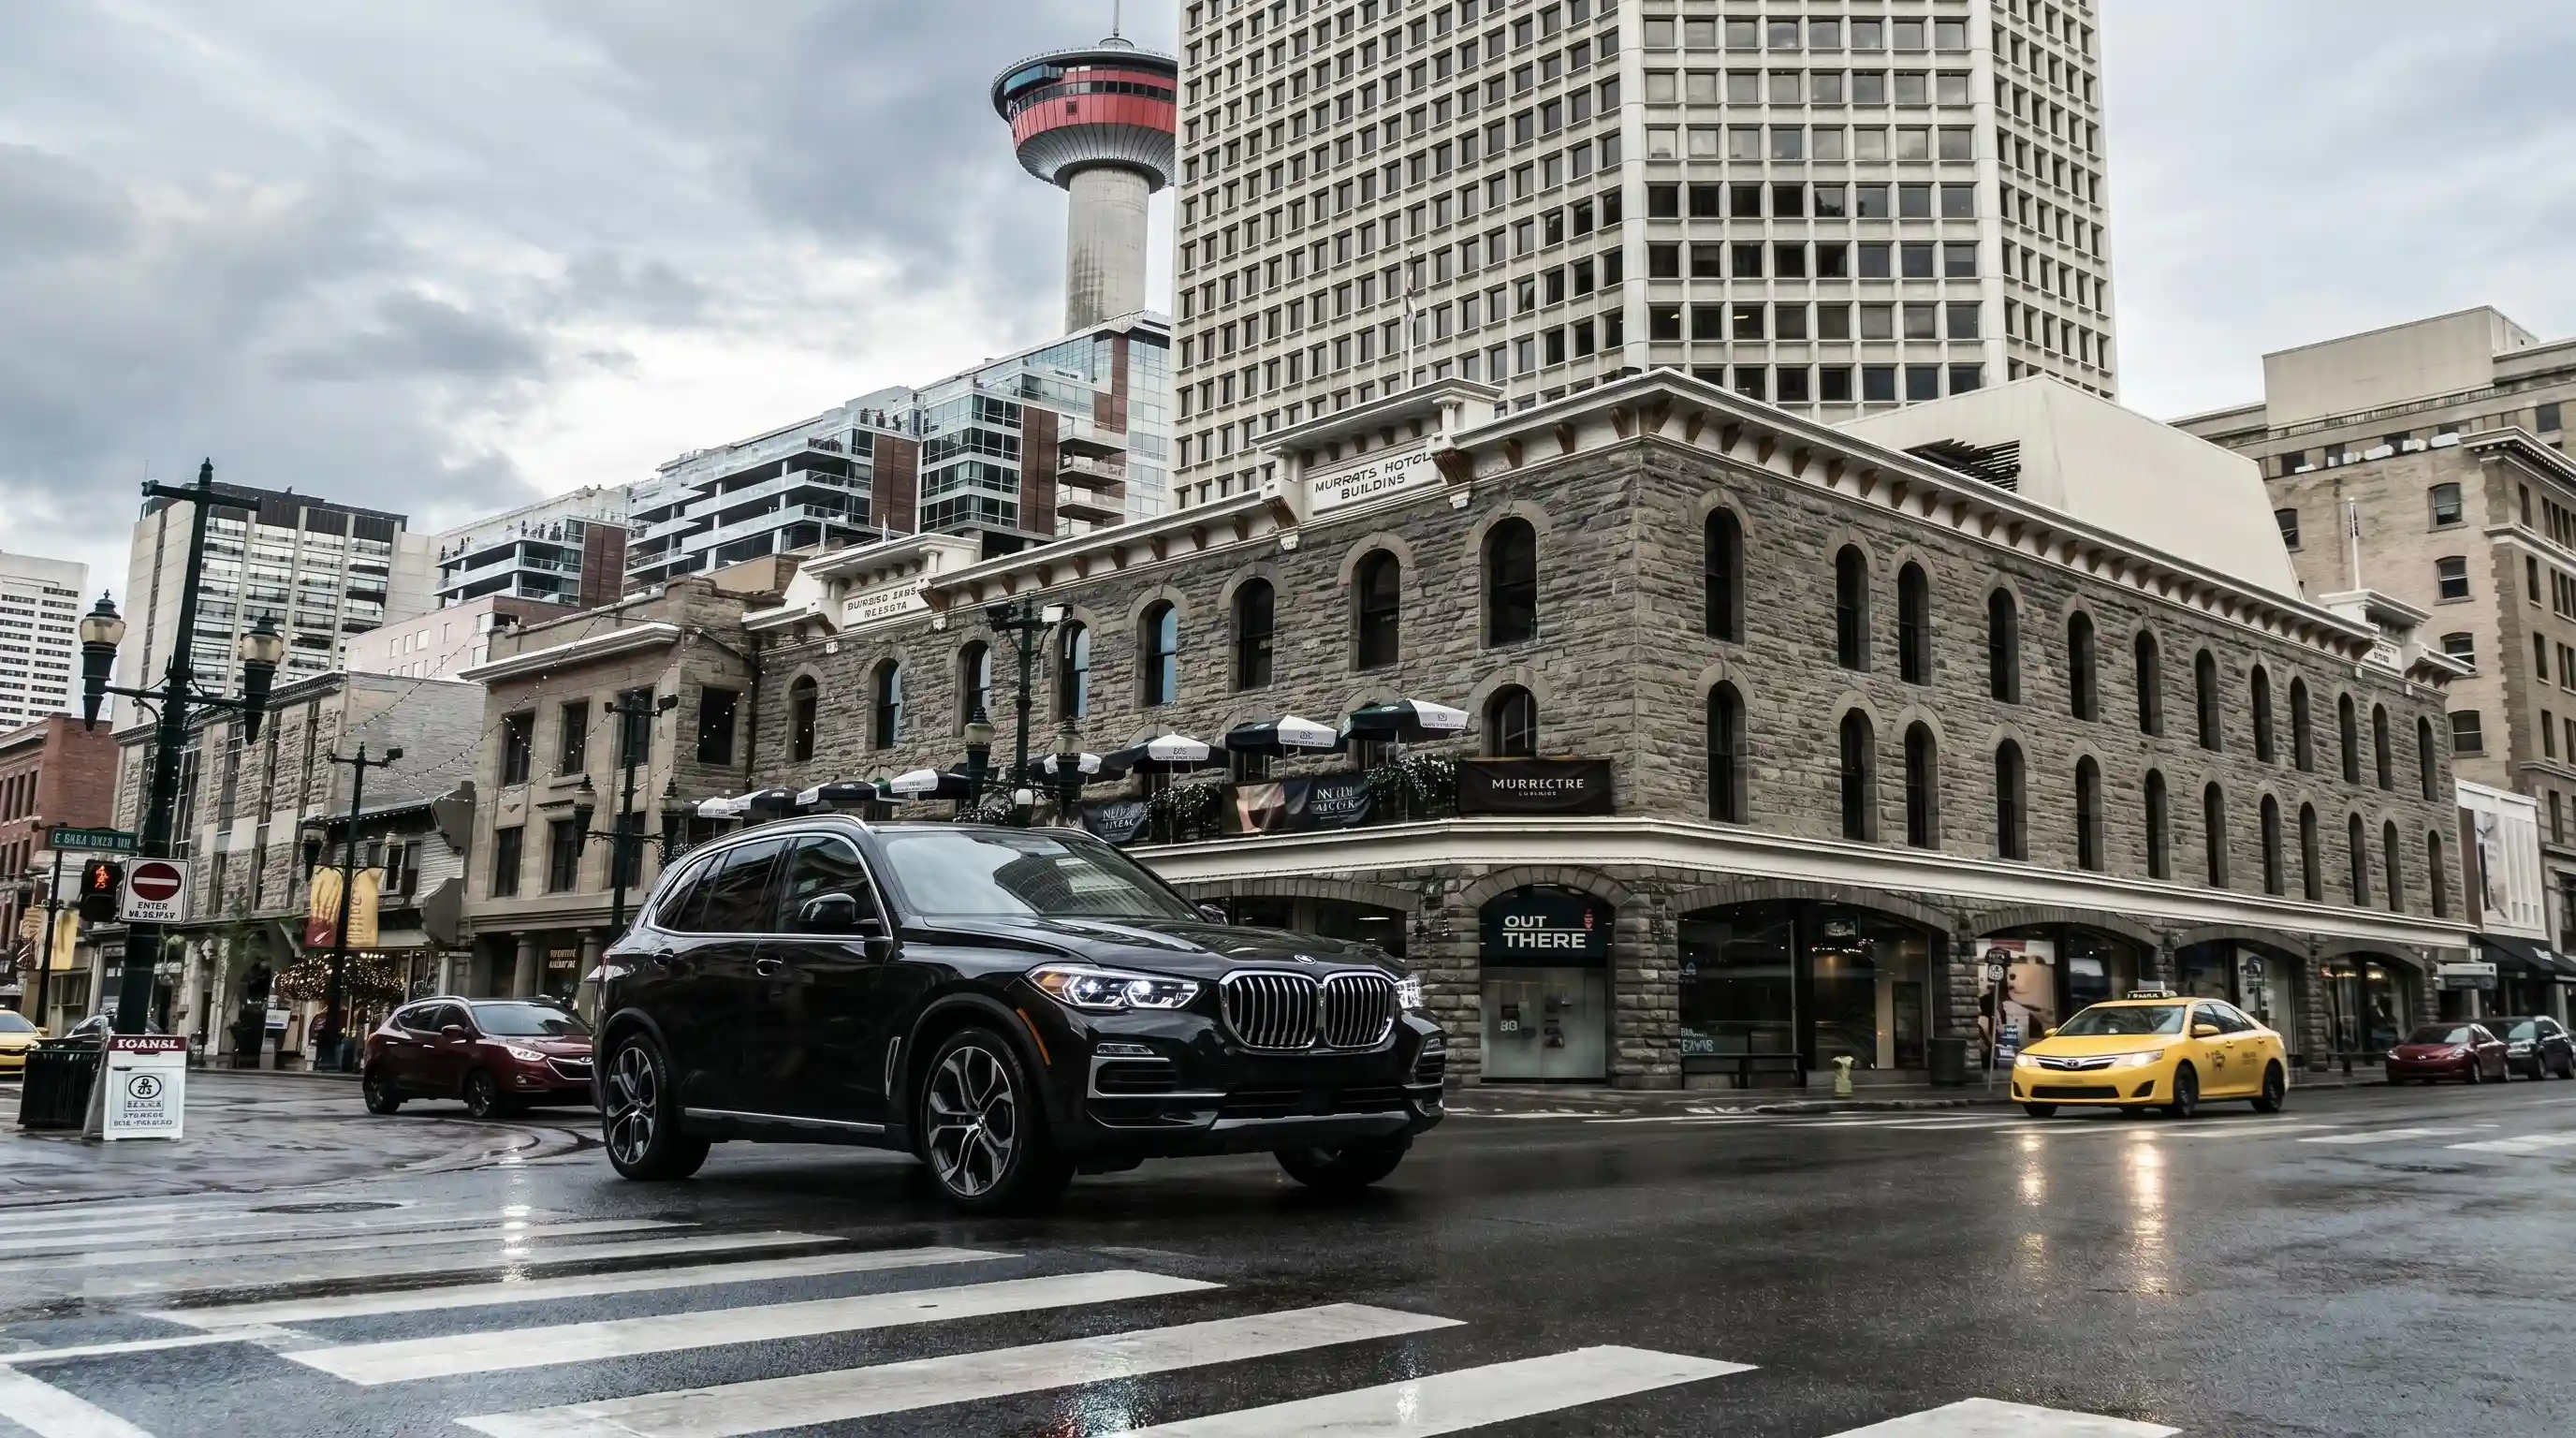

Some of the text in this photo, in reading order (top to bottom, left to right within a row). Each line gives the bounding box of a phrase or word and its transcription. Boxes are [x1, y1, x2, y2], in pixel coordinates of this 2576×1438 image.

[1315, 467, 1377, 493] MURRATS
[138, 902, 168, 911] ENTER
[1504, 915, 1547, 928] OUT
[1502, 932, 1587, 948] THERE
